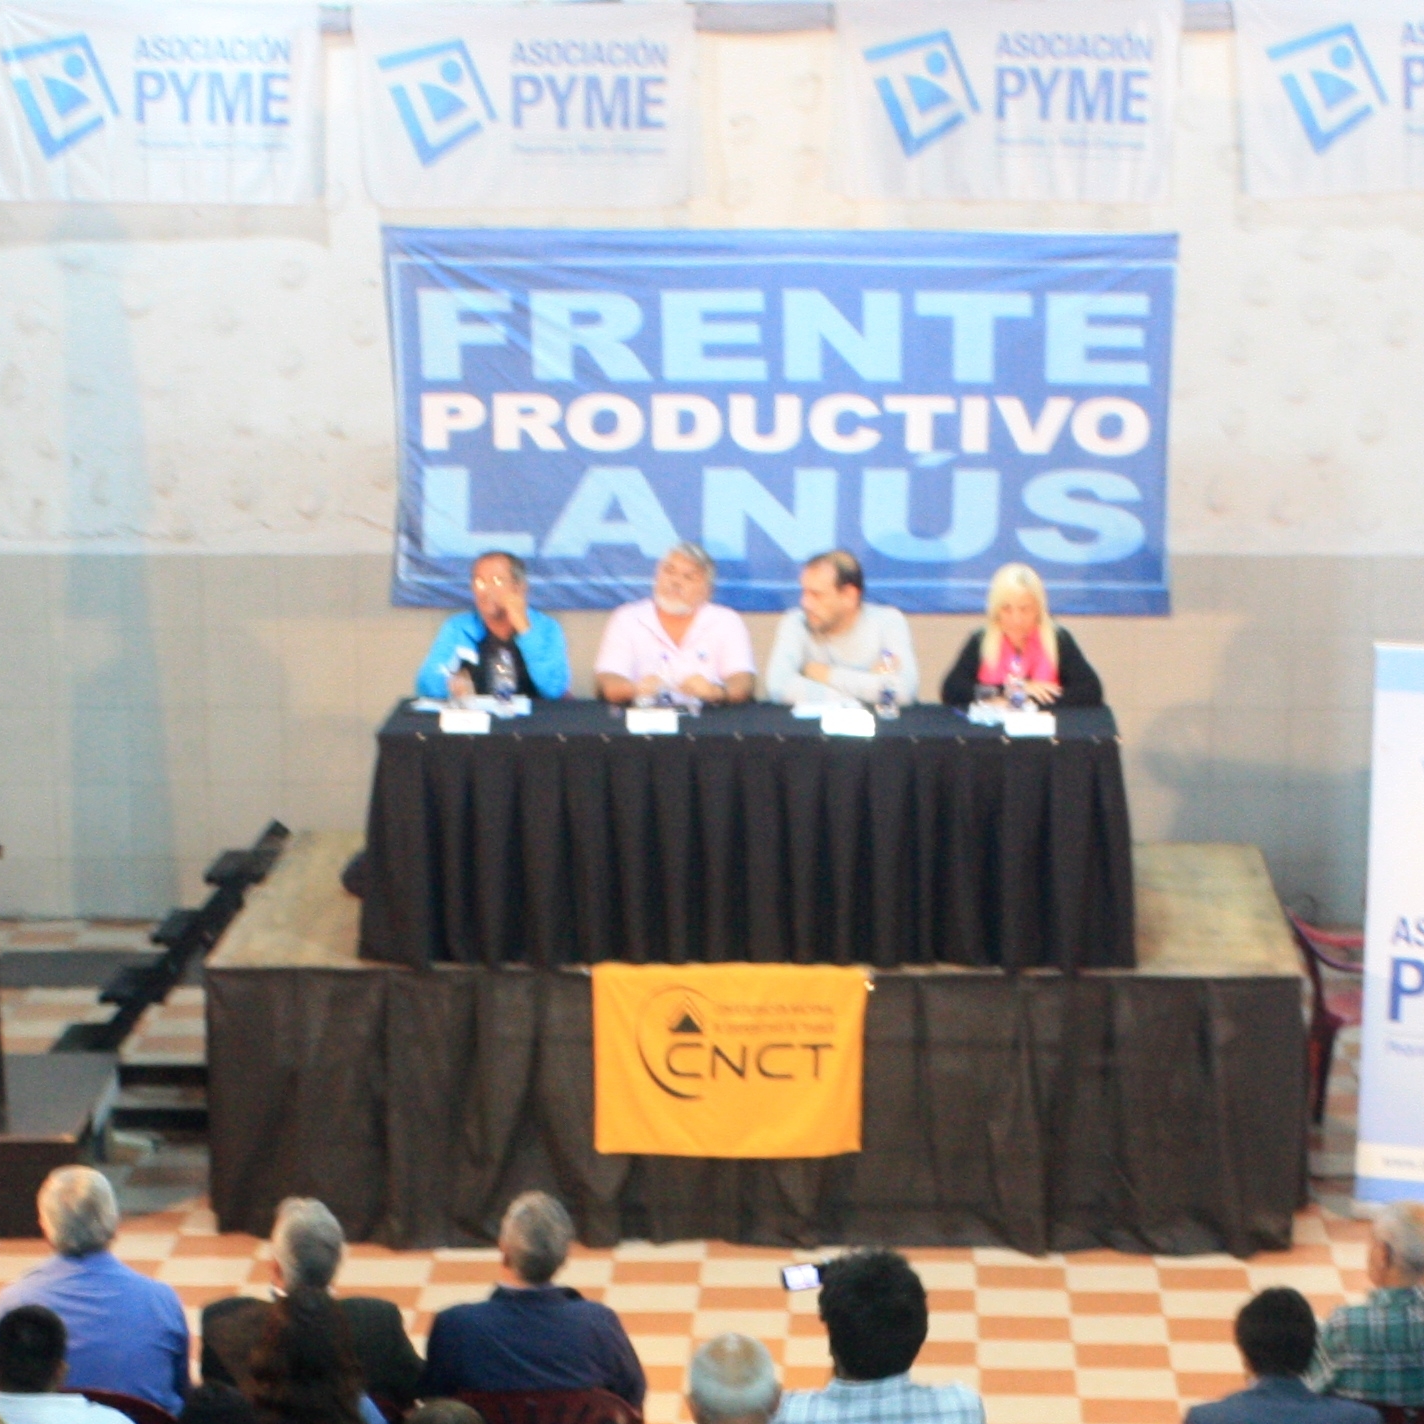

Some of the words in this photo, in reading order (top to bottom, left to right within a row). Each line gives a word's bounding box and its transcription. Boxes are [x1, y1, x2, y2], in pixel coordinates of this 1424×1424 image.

[133, 34, 293, 64] ASOCIACIÓN
[510, 37, 669, 68] ASOCIACIÓN
[995, 28, 1154, 62] ASOCIACIÓN
[134, 70, 292, 129] PYME
[511, 72, 669, 132] PYME
[994, 65, 1151, 126] PYME
[416, 287, 1152, 389] FRENTE
[420, 392, 1152, 457] PRODUCTIVO
[665, 1042, 834, 1080] CNCT
